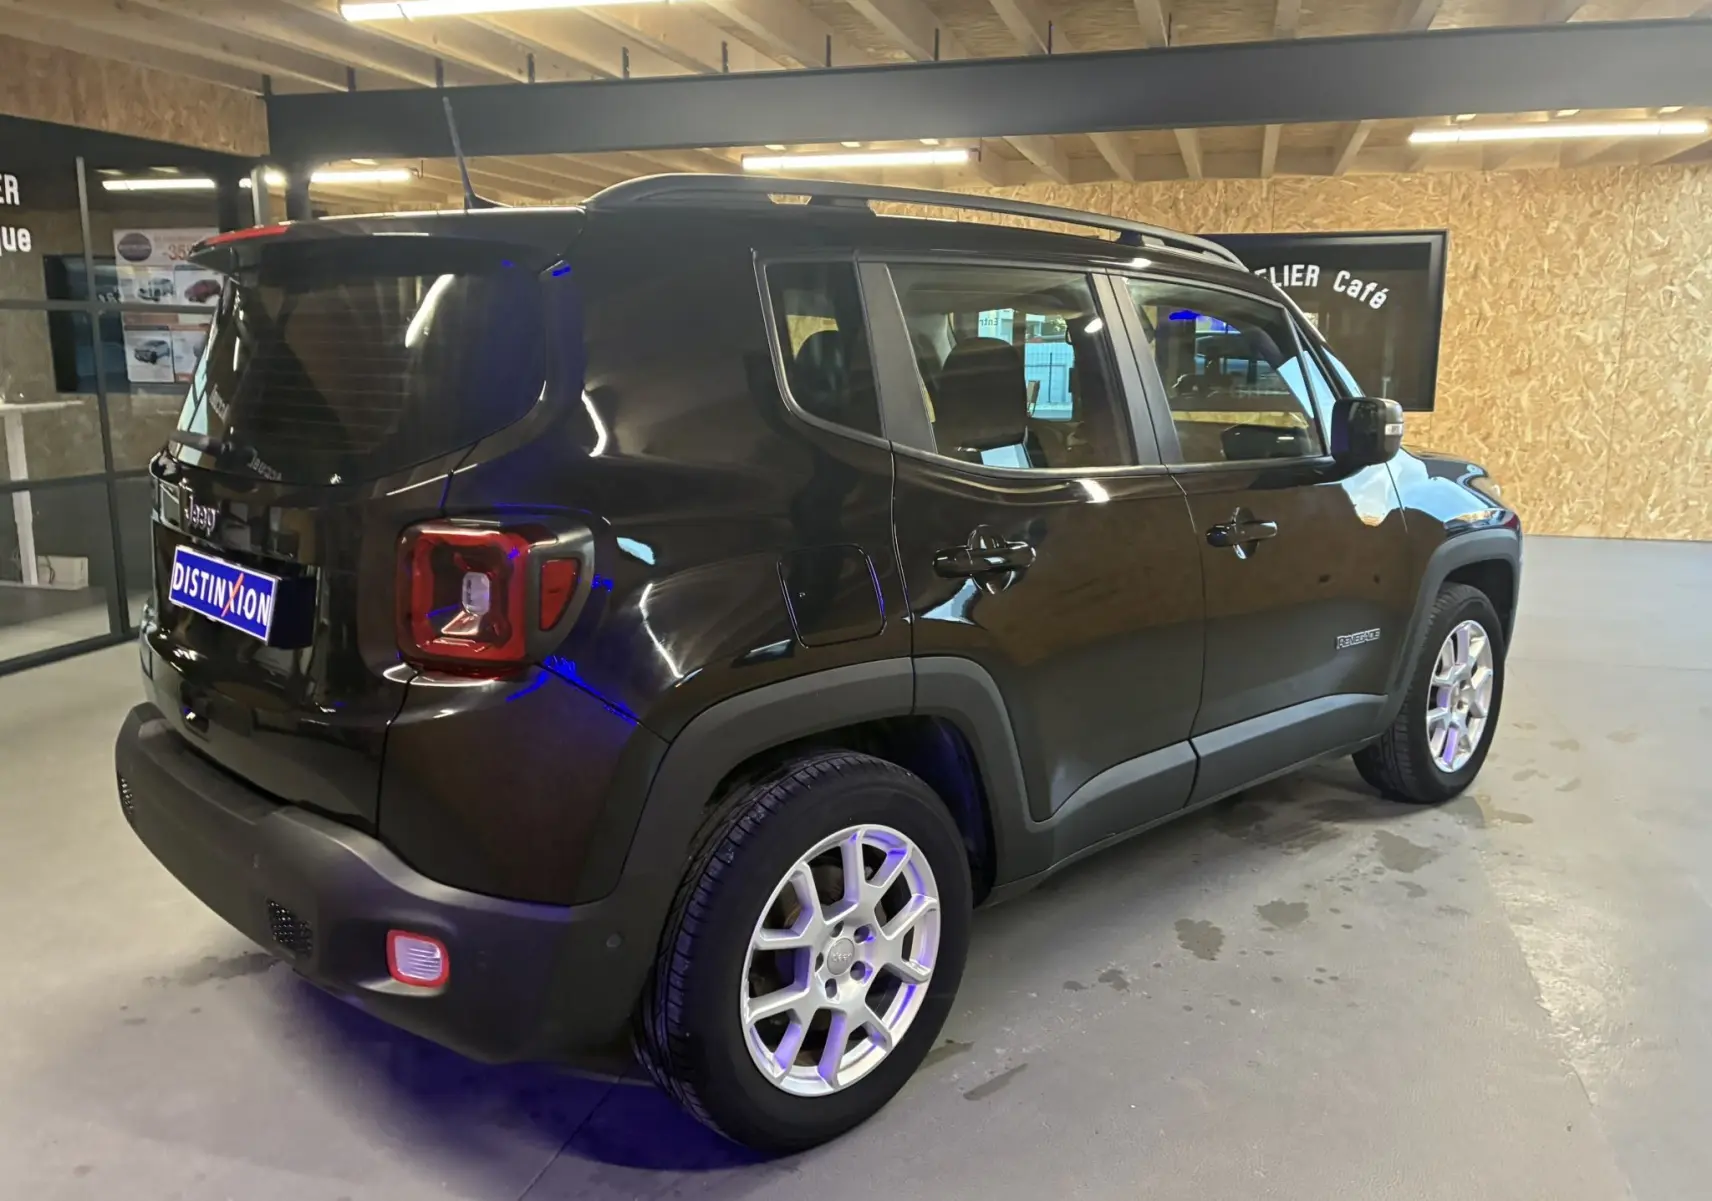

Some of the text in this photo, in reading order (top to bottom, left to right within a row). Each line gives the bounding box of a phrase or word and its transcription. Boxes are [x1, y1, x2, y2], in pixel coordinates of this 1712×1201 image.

[0, 226, 31, 256] ue
[1333, 270, 1389, 309] Café
[184, 494, 216, 536] Jeep
[172, 562, 272, 626] DISTINXION
[1336, 628, 1381, 649] RENEGADE
